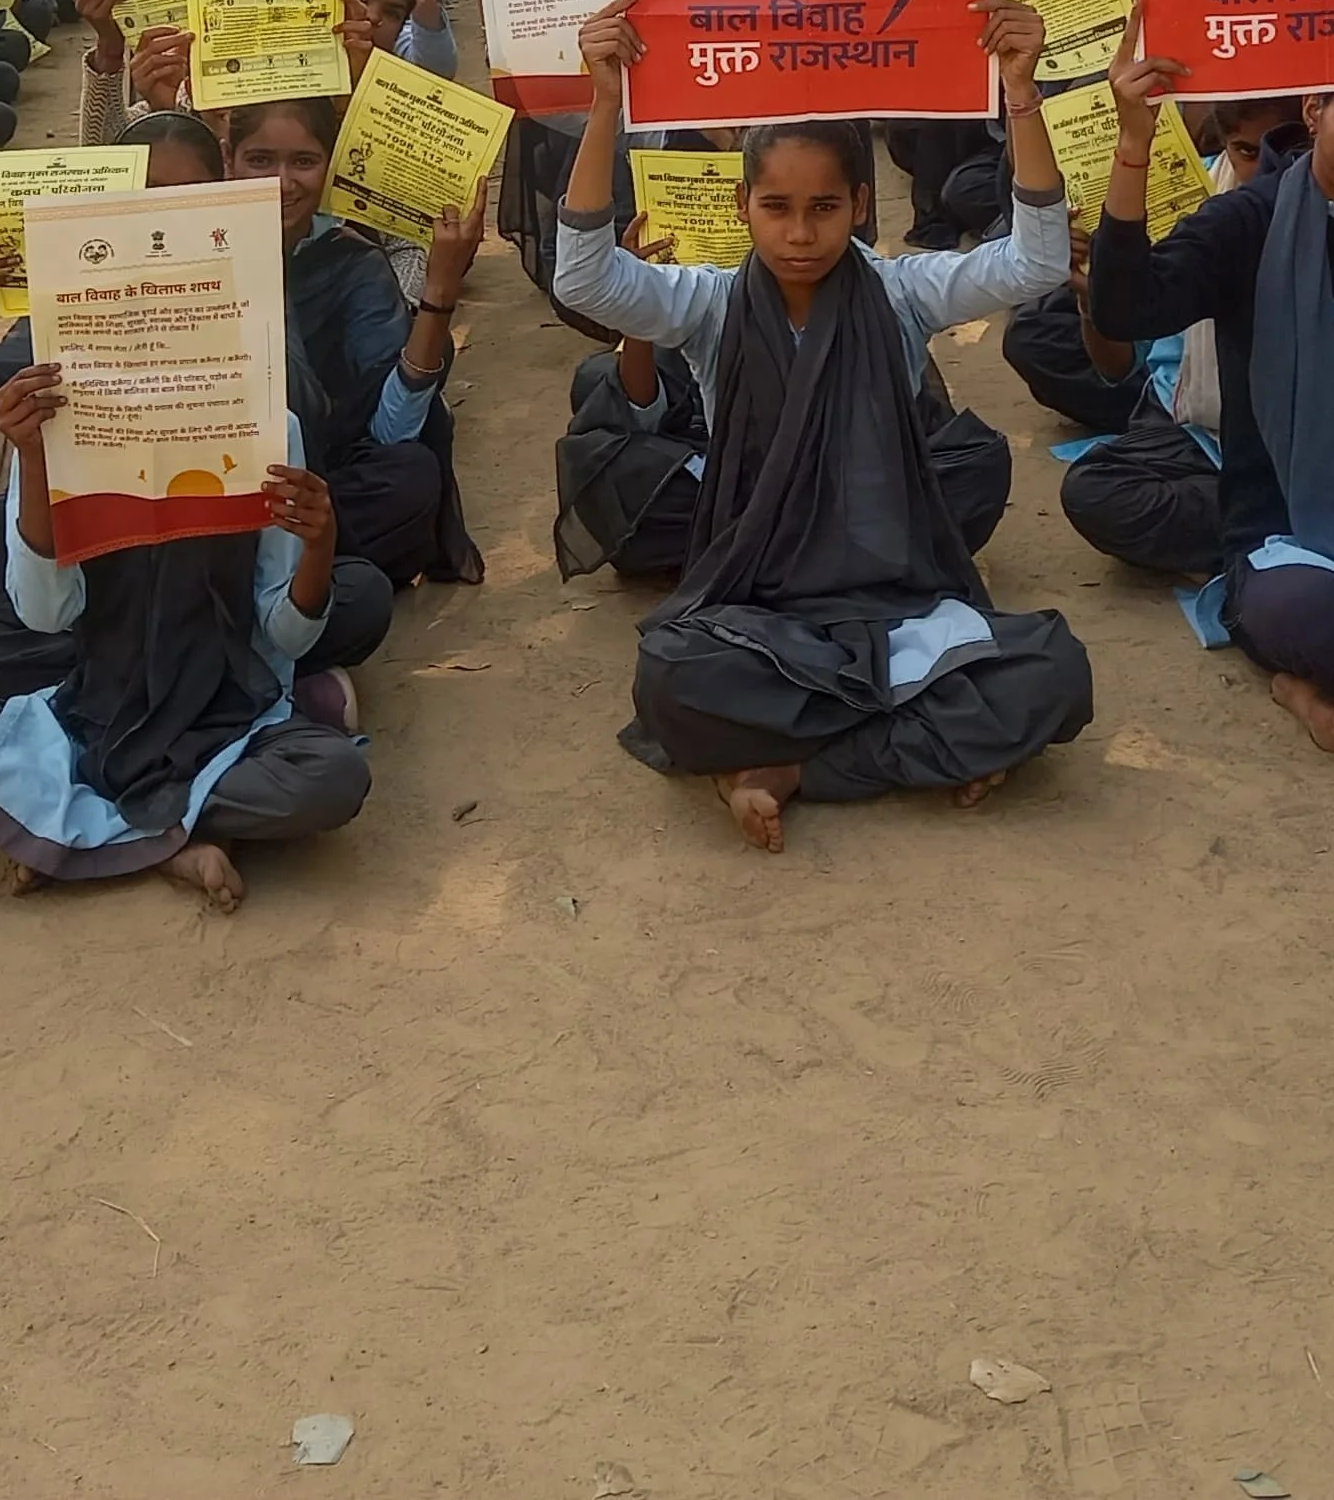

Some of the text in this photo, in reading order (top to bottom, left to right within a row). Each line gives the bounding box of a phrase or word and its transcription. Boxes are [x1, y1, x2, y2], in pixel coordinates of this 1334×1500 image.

[687, 5, 761, 32] बाल
[1204, 12, 1279, 59] मुक्त
[687, 39, 919, 87] मुक्त राजस्थान
[1101, 116, 1120, 131] परि
[422, 150, 444, 165] 112
[51, 184, 105, 195] परियोजना
[8, 198, 24, 208] विव
[56, 280, 222, 304] बाल विवाह के खिलाफ शपथ
